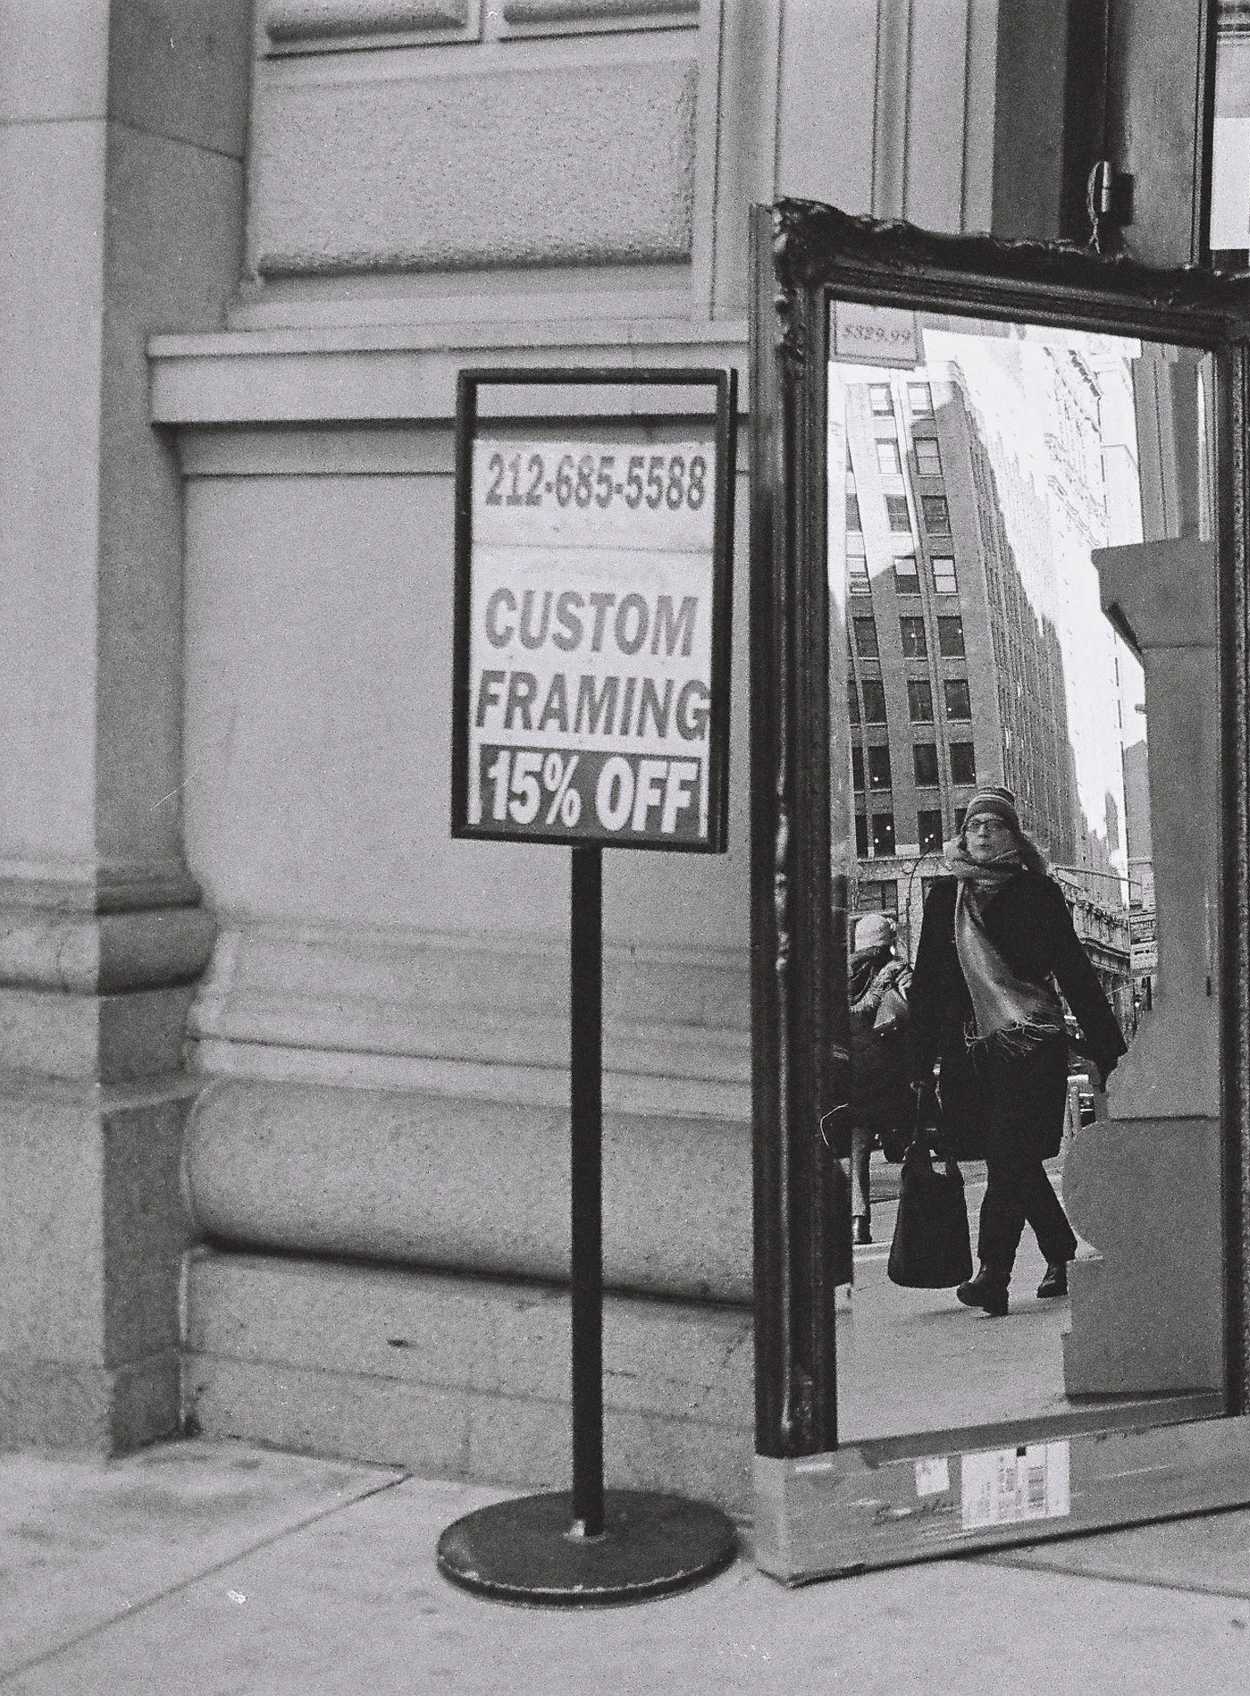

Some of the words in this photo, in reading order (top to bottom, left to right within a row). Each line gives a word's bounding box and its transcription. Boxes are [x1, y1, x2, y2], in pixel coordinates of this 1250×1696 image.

[485, 587, 698, 656] CUSTOM
[476, 670, 711, 740] FRAMING
[487, 750, 582, 828] 15%
[595, 755, 700, 834] OFF
